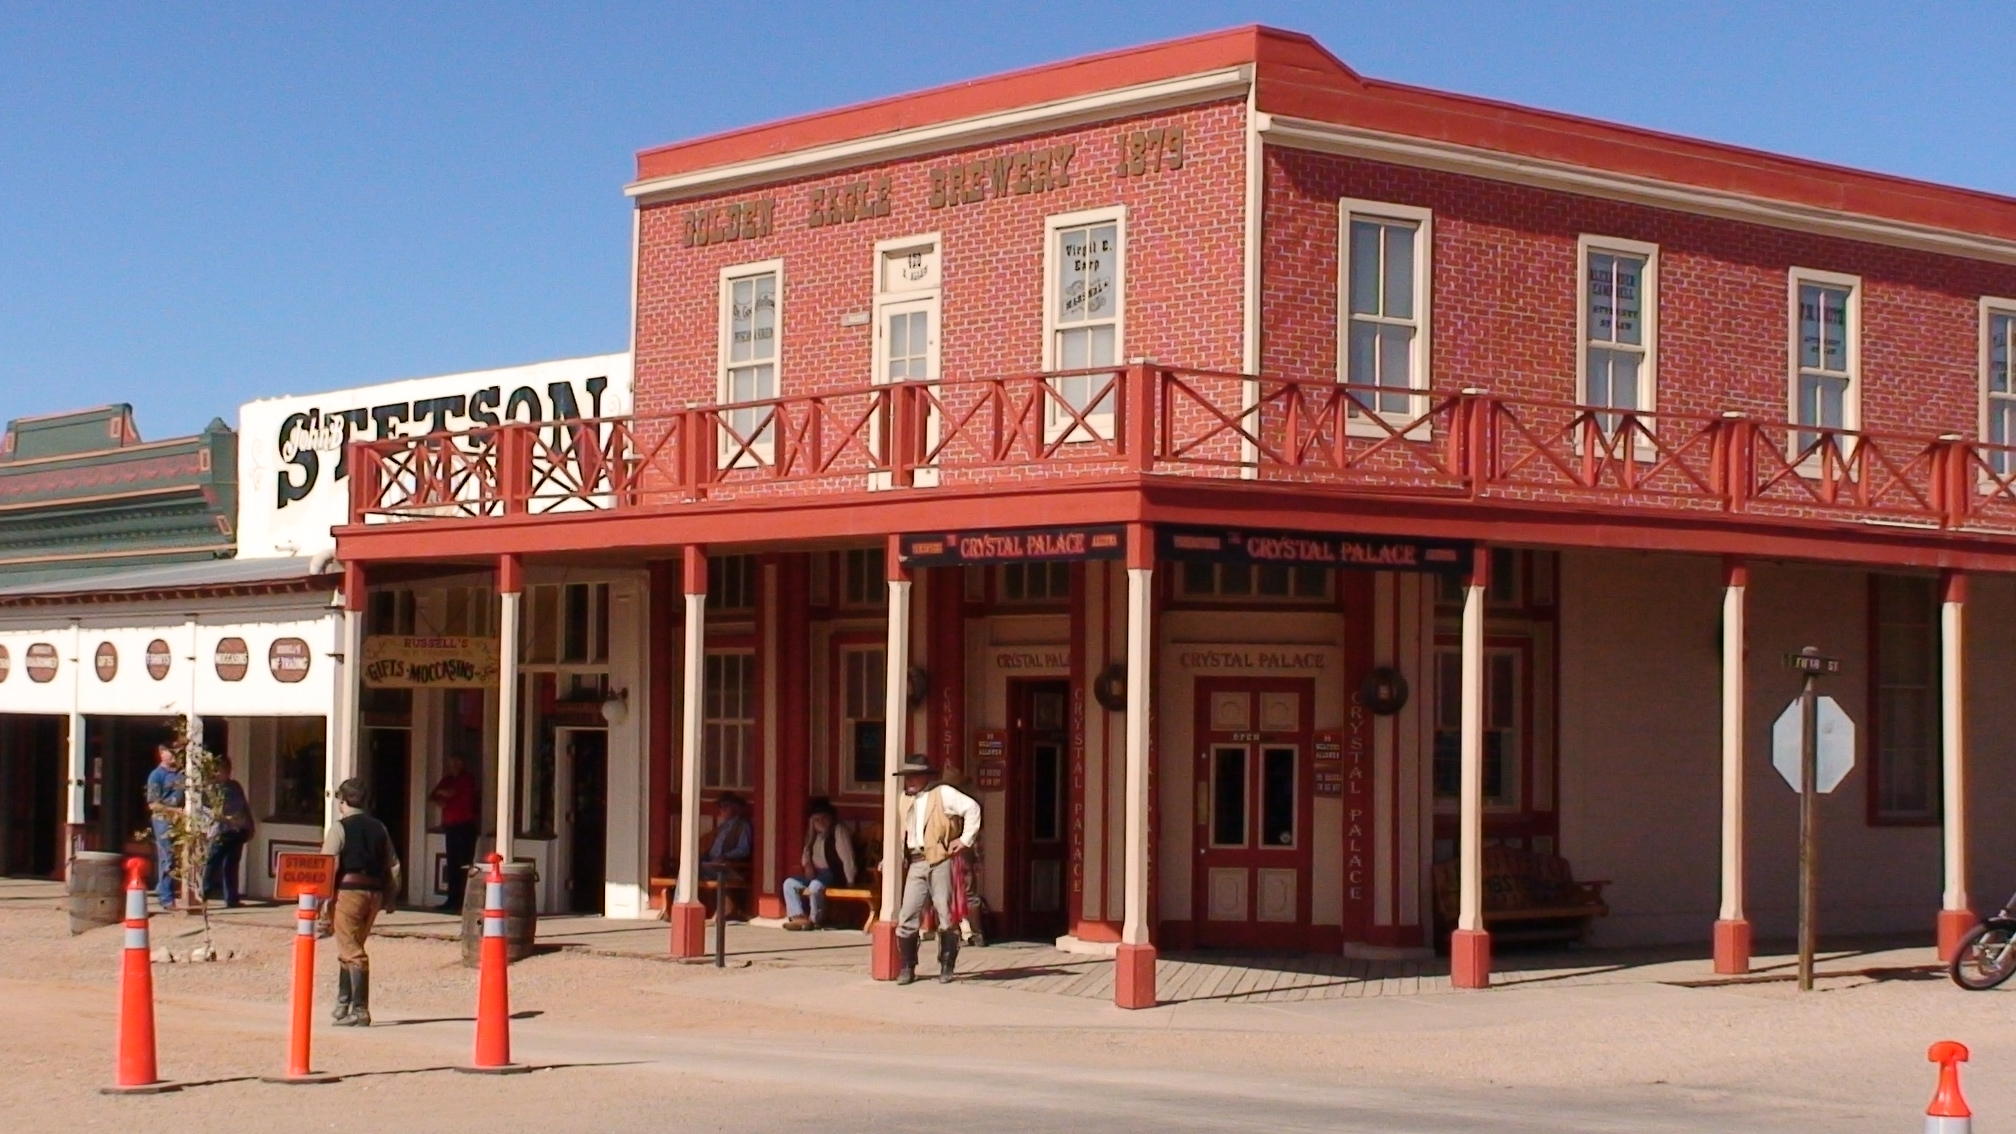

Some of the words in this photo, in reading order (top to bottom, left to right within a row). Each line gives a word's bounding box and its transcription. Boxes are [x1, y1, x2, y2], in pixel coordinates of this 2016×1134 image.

[682, 197, 776, 249] GOLDEN
[808, 176, 892, 228] EAGLE
[928, 144, 1075, 210] BREWERY
[1115, 128, 1184, 178] 1879
[277, 376, 608, 509] STETSON
[283, 417, 329, 463] John
[960, 534, 1024, 559] CRYSTAL
[1026, 532, 1085, 556] PALACE
[1247, 536, 1335, 561] CRYSTAL
[1340, 541, 1417, 566] PALACE
[404, 638, 469, 649] RUSSELL'S
[366, 659, 405, 683] GIFTS
[996, 652, 1043, 668] CRYSTAL
[1180, 651, 1254, 669] CRYSTAL
[1258, 652, 1325, 669] PALACE
[943, 687, 954, 770] CRYSTA
[1073, 688, 1084, 789] CRYSTAL
[1233, 732, 1260, 741] OPEN
[1349, 691, 1364, 794] CRYSTAL
[286, 857, 327, 869] STREET
[1072, 803, 1083, 893] PALACE
[1348, 809, 1363, 900] PALACE
[284, 871, 327, 883] CLOSED
